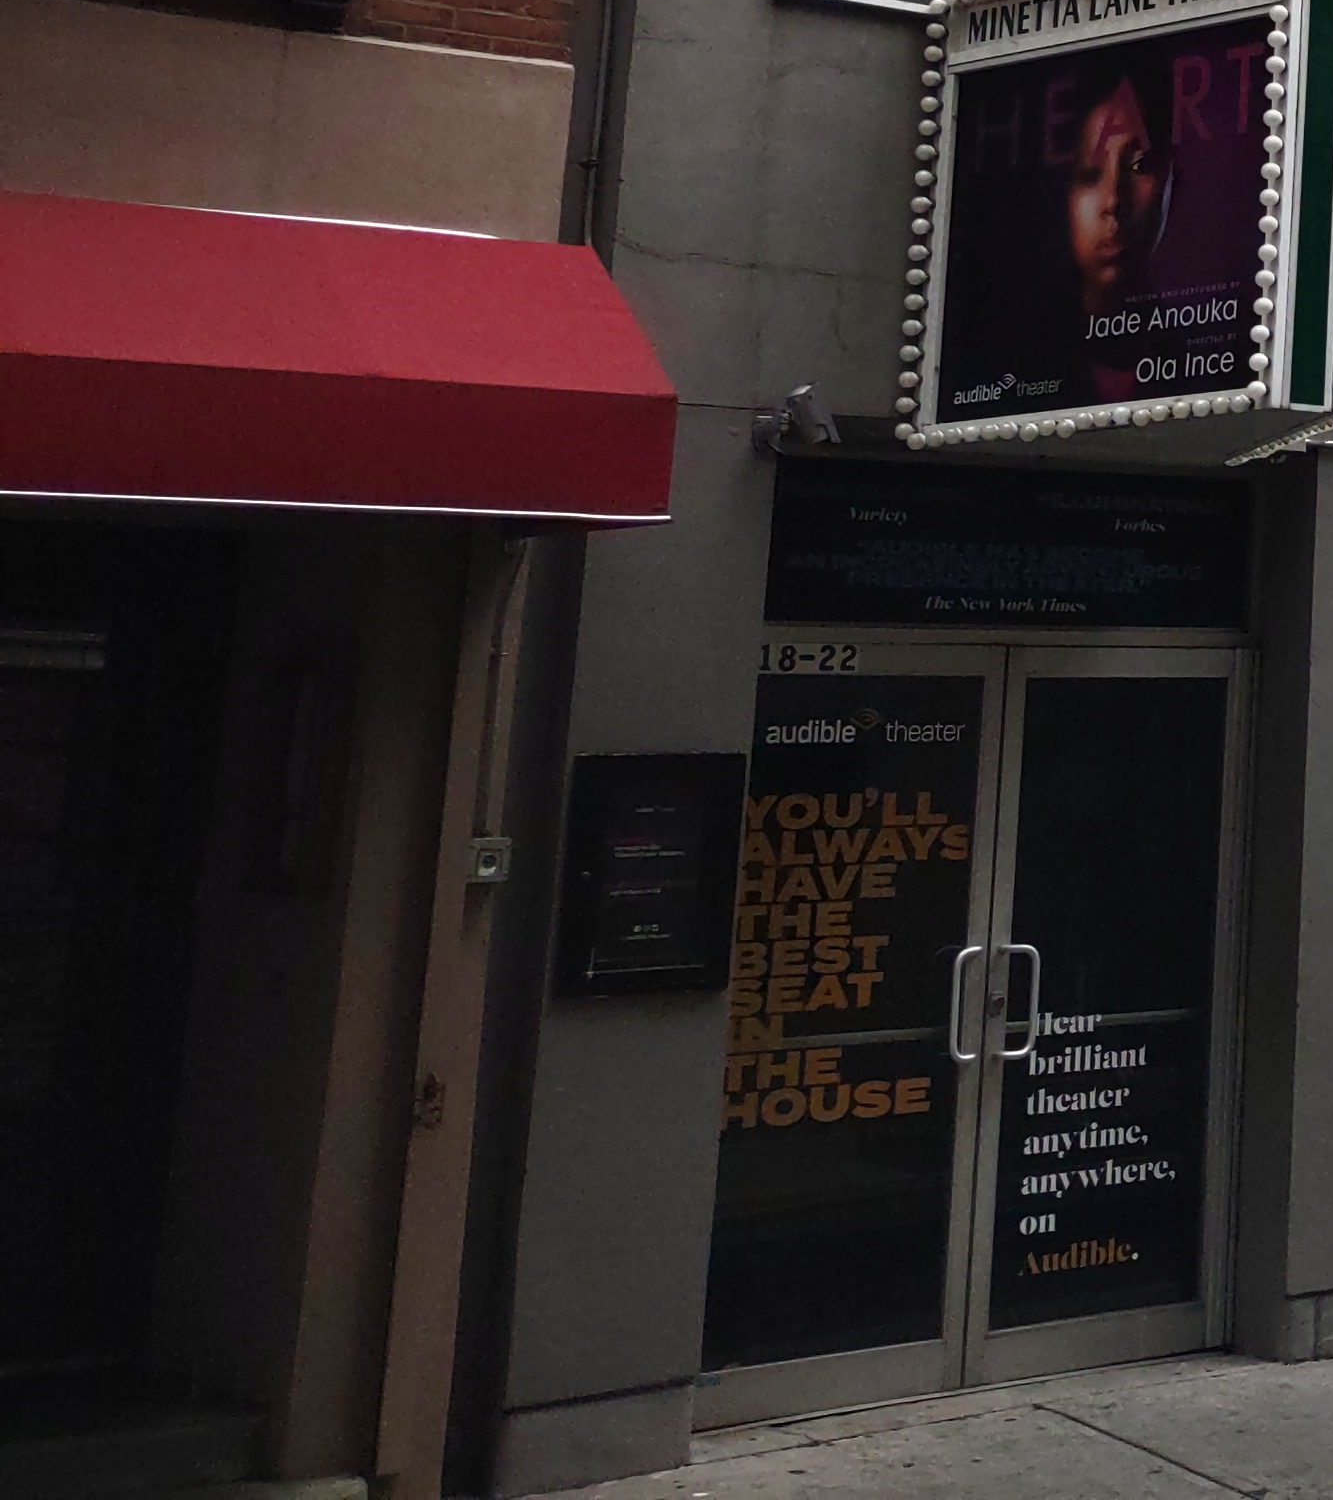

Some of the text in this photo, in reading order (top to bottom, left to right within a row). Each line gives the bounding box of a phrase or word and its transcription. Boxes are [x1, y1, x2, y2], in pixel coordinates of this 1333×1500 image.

[976, 44, 1265, 172] HEART
[1086, 297, 1238, 340] Jade Anouka
[1135, 345, 1235, 384] Ola Ince
[953, 376, 1061, 406] audible theater
[844, 506, 909, 528] Variety
[1113, 517, 1168, 534] Forbes
[923, 595, 953, 611] The
[957, 596, 991, 611] New
[1038, 597, 1088, 613] Times
[759, 644, 858, 673] 18-22
[765, 719, 965, 745] audible theater
[747, 787, 948, 833] YOU'LL
[744, 824, 972, 866] ALWAYS
[739, 863, 896, 904] HAVE
[737, 901, 852, 942] THE
[736, 934, 890, 979] BEST
[731, 971, 884, 1016] SEAT
[730, 1014, 784, 1056] IN
[1033, 1011, 1103, 1038] Hear
[725, 1047, 842, 1092] THE
[1028, 1043, 1147, 1077] brilliant
[721, 1077, 932, 1132] HOUSE
[1026, 1083, 1131, 1116] theater
[1023, 1121, 1150, 1160] anytime,
[1021, 1156, 1177, 1199] anywhere,
[1019, 1211, 1057, 1236] on
[1018, 1236, 1140, 1277] Audible.
